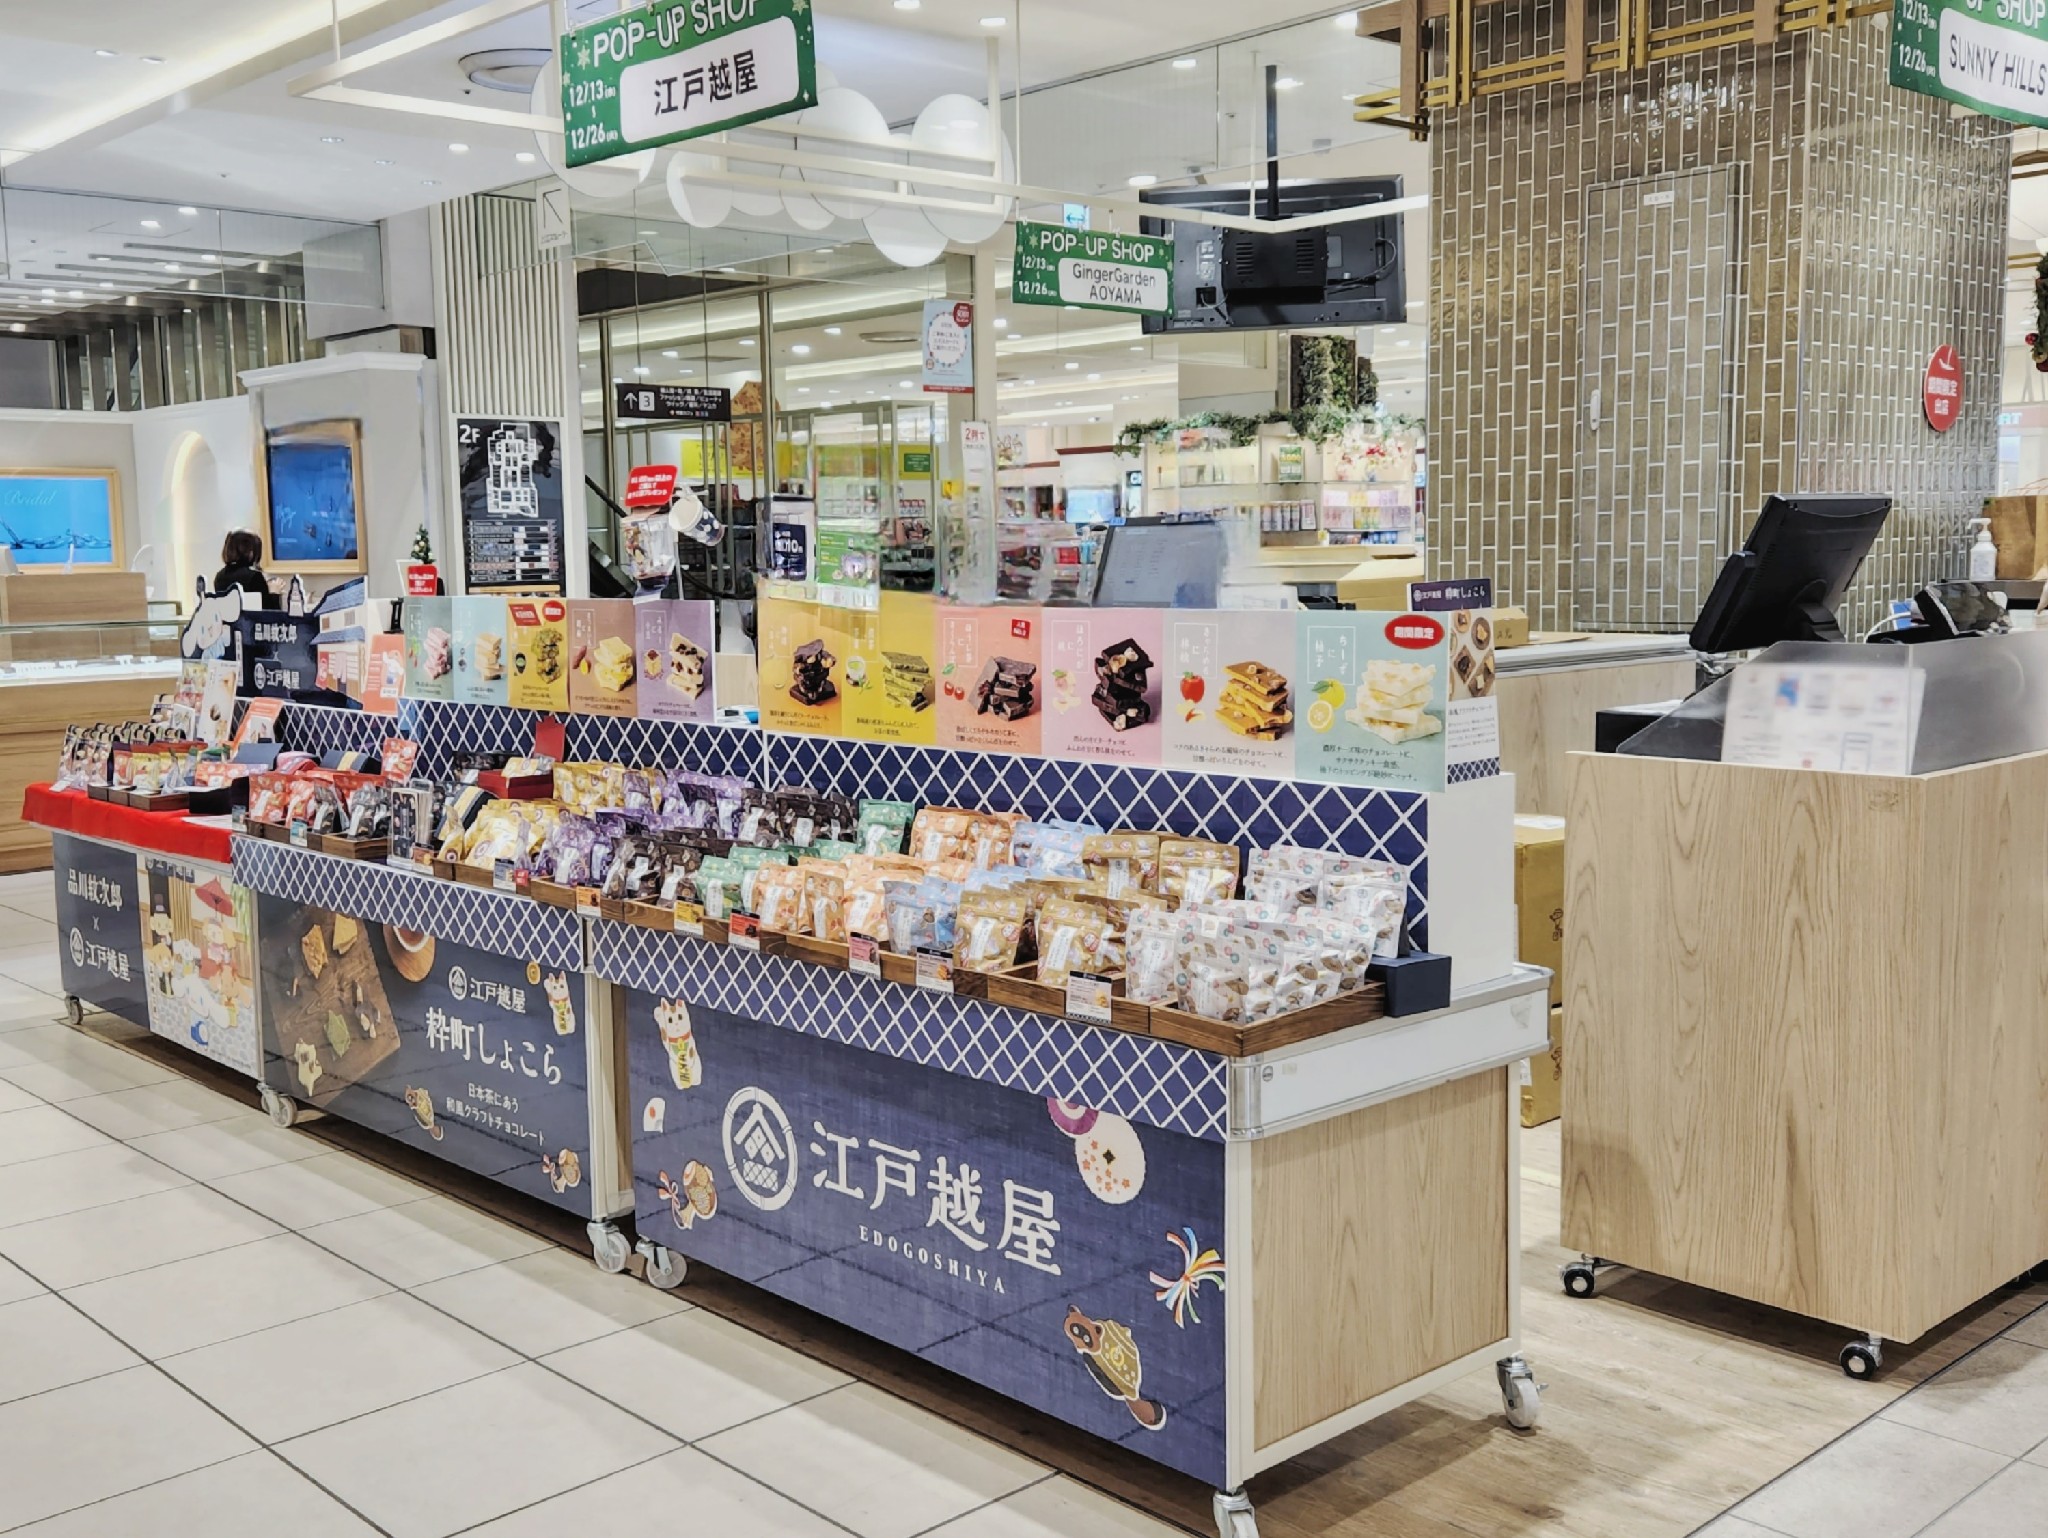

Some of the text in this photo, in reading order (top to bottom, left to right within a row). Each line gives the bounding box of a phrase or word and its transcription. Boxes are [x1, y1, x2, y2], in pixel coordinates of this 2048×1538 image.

[593, 5, 686, 67] POP-UP
[654, 49, 758, 115] 江戸越屋
[1950, 34, 2047, 96] SUNNY HILLS
[1041, 231, 1155, 263] POP-UP SHOP
[1072, 262, 1156, 288] GingerGarden
[1089, 285, 1143, 304] AOYAMA
[643, 395, 651, 407] 3
[459, 424, 481, 444] 2F
[267, 669, 300, 690] 江戸越屋
[67, 868, 122, 911] 品川紋次郎
[86, 941, 131, 982] 江戸越屋
[470, 977, 526, 1014] 江戸越屋
[426, 1006, 562, 1085] 粋町しょこら
[467, 1082, 519, 1113] 日本茶にあう
[446, 1097, 545, 1146] 和風クラフトチョコレート
[809, 1120, 1062, 1276] 江戸越屋
[859, 1224, 1006, 1294] EDOGOSHIYA
